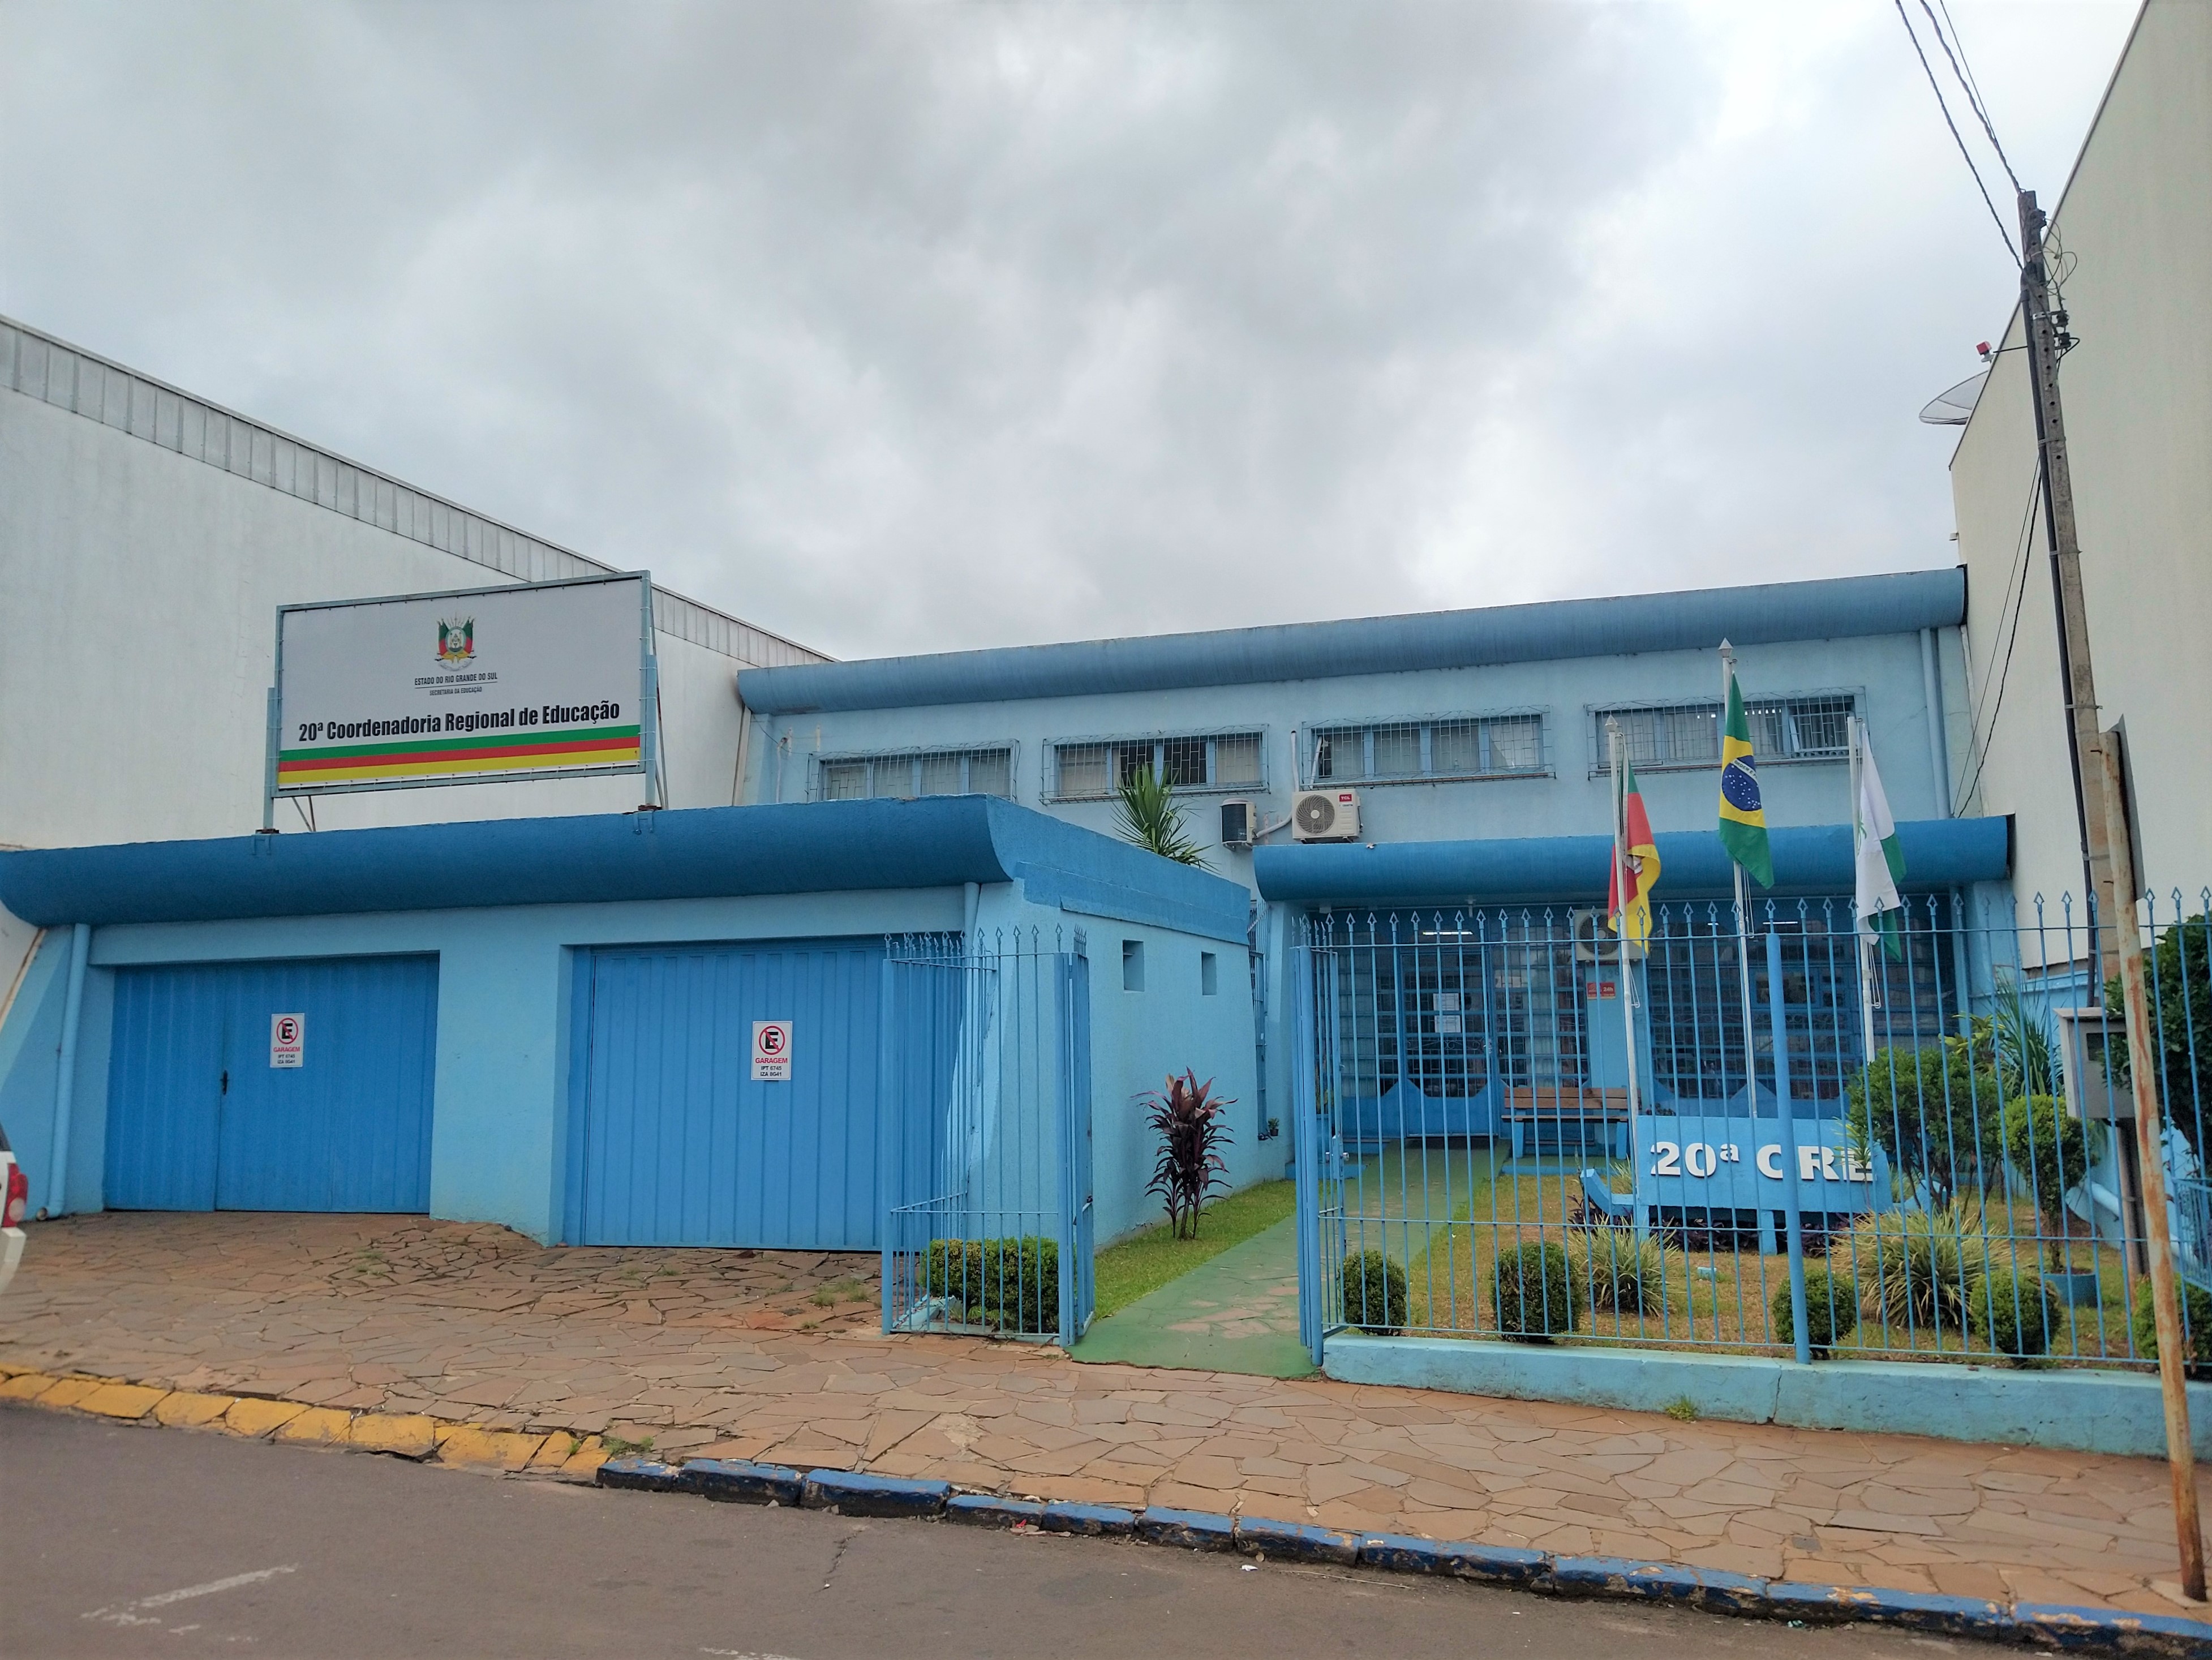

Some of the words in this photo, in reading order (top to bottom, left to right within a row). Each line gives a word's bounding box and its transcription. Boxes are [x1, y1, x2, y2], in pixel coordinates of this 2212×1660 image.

[415, 677, 434, 685] ESTADO
[436, 675, 443, 684] DO
[456, 674, 476, 682] GRANDE
[461, 685, 482, 694] EDUCAÇÃO
[327, 715, 441, 740] Coordenadoria
[445, 708, 514, 732] Regional
[519, 707, 538, 726] de
[543, 700, 620, 724] Educação
[1734, 760, 1750, 771] ORDEM
[1756, 1144, 1874, 1182] CRE
